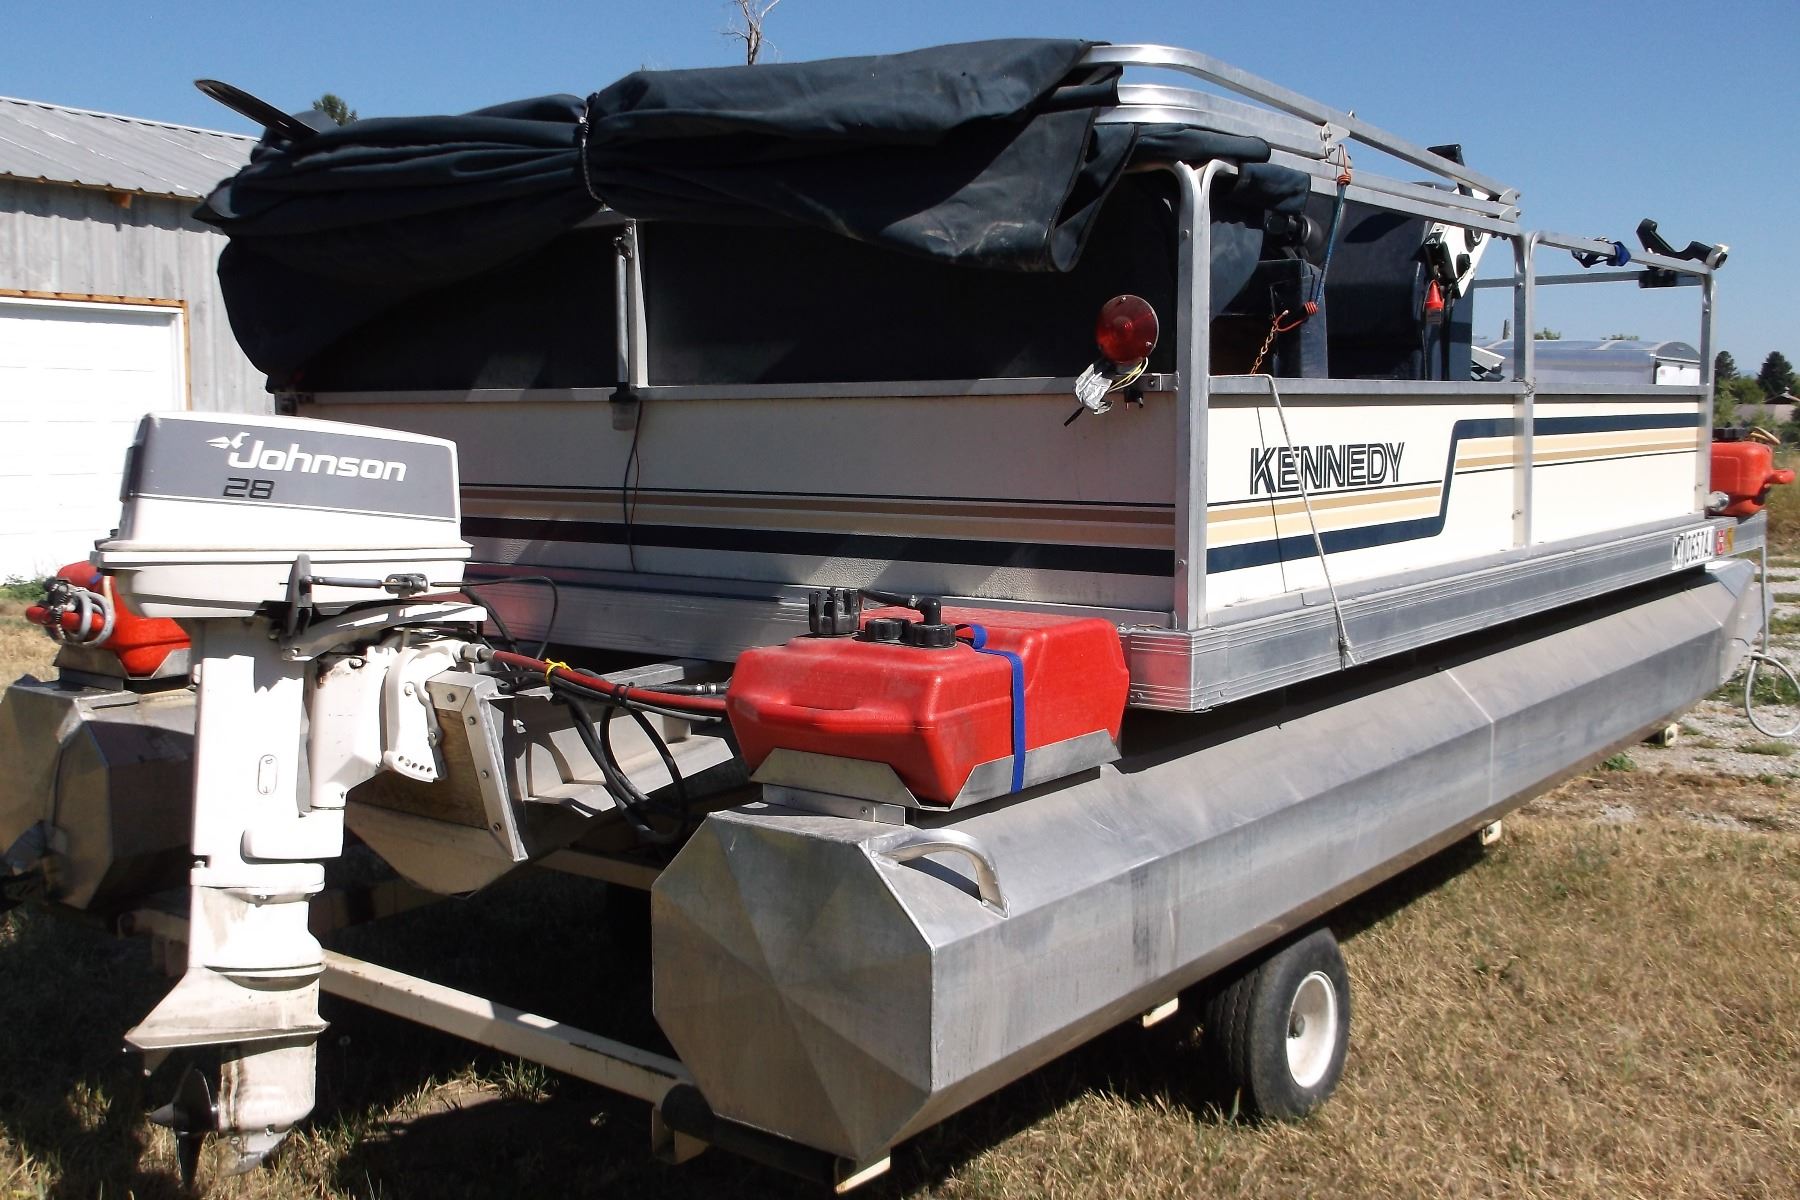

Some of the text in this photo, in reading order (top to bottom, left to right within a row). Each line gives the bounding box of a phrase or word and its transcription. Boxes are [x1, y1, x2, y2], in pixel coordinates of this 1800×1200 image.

[227, 440, 407, 482] Johnson
[1249, 441, 1405, 495] KENNEDY
[222, 477, 275, 500] 28
